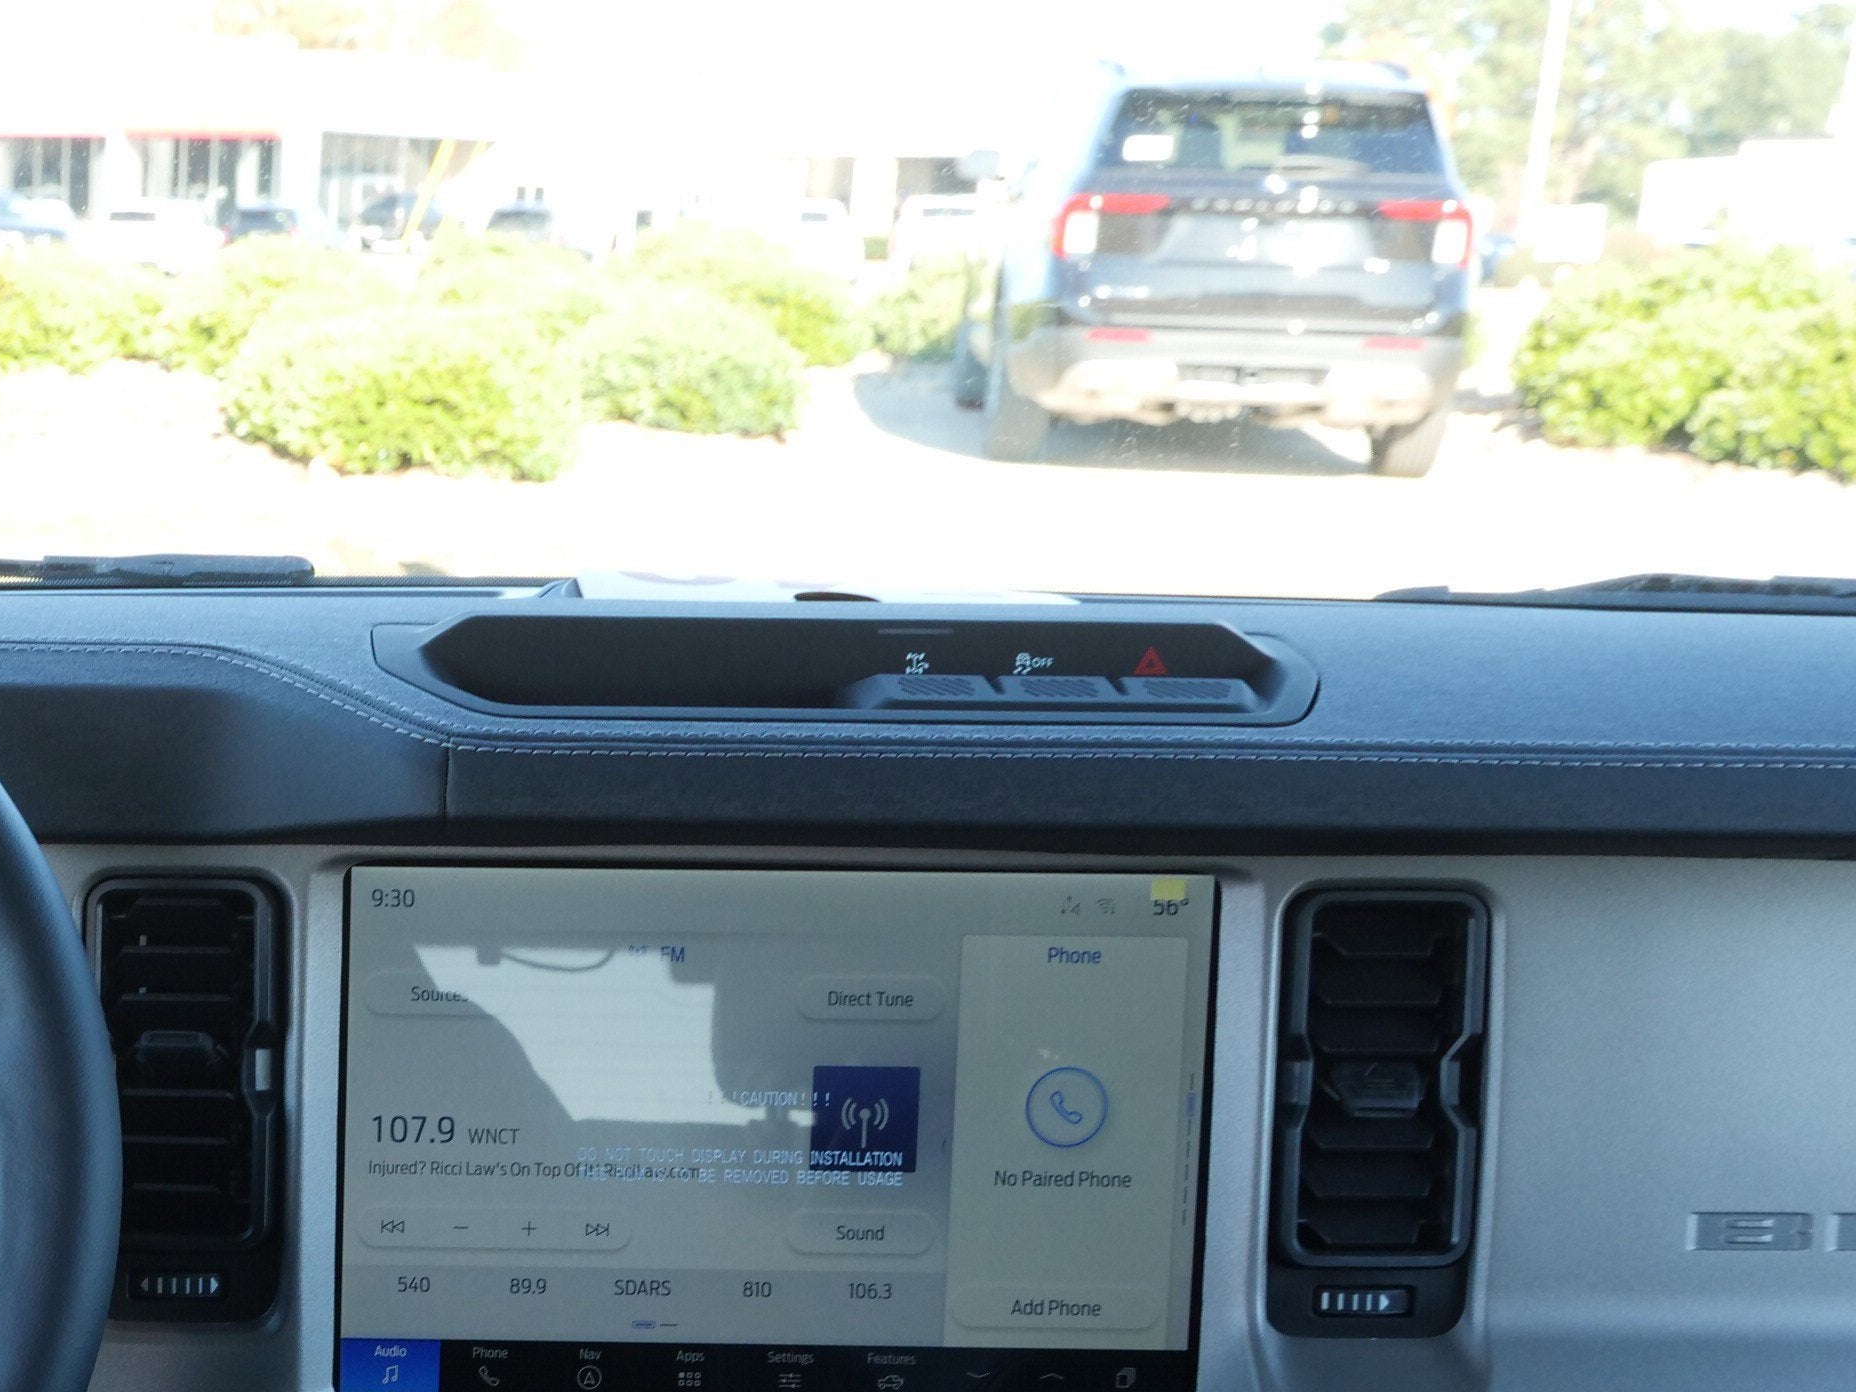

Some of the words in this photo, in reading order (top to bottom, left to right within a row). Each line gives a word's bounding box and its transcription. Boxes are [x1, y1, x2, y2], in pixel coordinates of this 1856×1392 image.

[1031, 656, 1054, 668] OFF
[371, 889, 416, 908] 9:30
[1047, 947, 1102, 965] Phone
[827, 990, 872, 1008] Direct
[876, 991, 914, 1009] Tune
[372, 1115, 455, 1144] 107.9
[468, 1127, 520, 1145] WNCT
[692, 1149, 746, 1165] DISPLAY
[753, 1150, 804, 1165] DURING
[810, 1150, 903, 1167] INSTALLATION
[368, 1160, 426, 1177] Injured?
[430, 1160, 462, 1176] Ricci
[466, 1161, 507, 1177] Law's
[510, 1162, 530, 1177] On
[534, 1162, 561, 1179] Top
[564, 1162, 581, 1177] Of
[723, 1169, 789, 1185] REMOVED
[797, 1170, 850, 1186] BEFORE
[857, 1171, 903, 1187] USAGE
[994, 1170, 1017, 1187] No
[1021, 1169, 1075, 1188] Paired
[1078, 1171, 1132, 1189] Phone
[836, 1224, 885, 1242] Sound
[397, 1276, 431, 1293] 540
[509, 1278, 547, 1295] 89.9
[613, 1279, 672, 1297] SDARS
[742, 1281, 772, 1298] 810
[848, 1283, 893, 1300] 106.3
[1010, 1299, 1044, 1316] Add
[1047, 1300, 1102, 1317] Phone
[374, 1344, 407, 1358] Audio
[472, 1346, 508, 1360] Phone
[579, 1347, 601, 1361] Nav
[675, 1350, 705, 1364] Apps
[767, 1351, 815, 1366] Settings
[867, 1352, 917, 1366] Features
